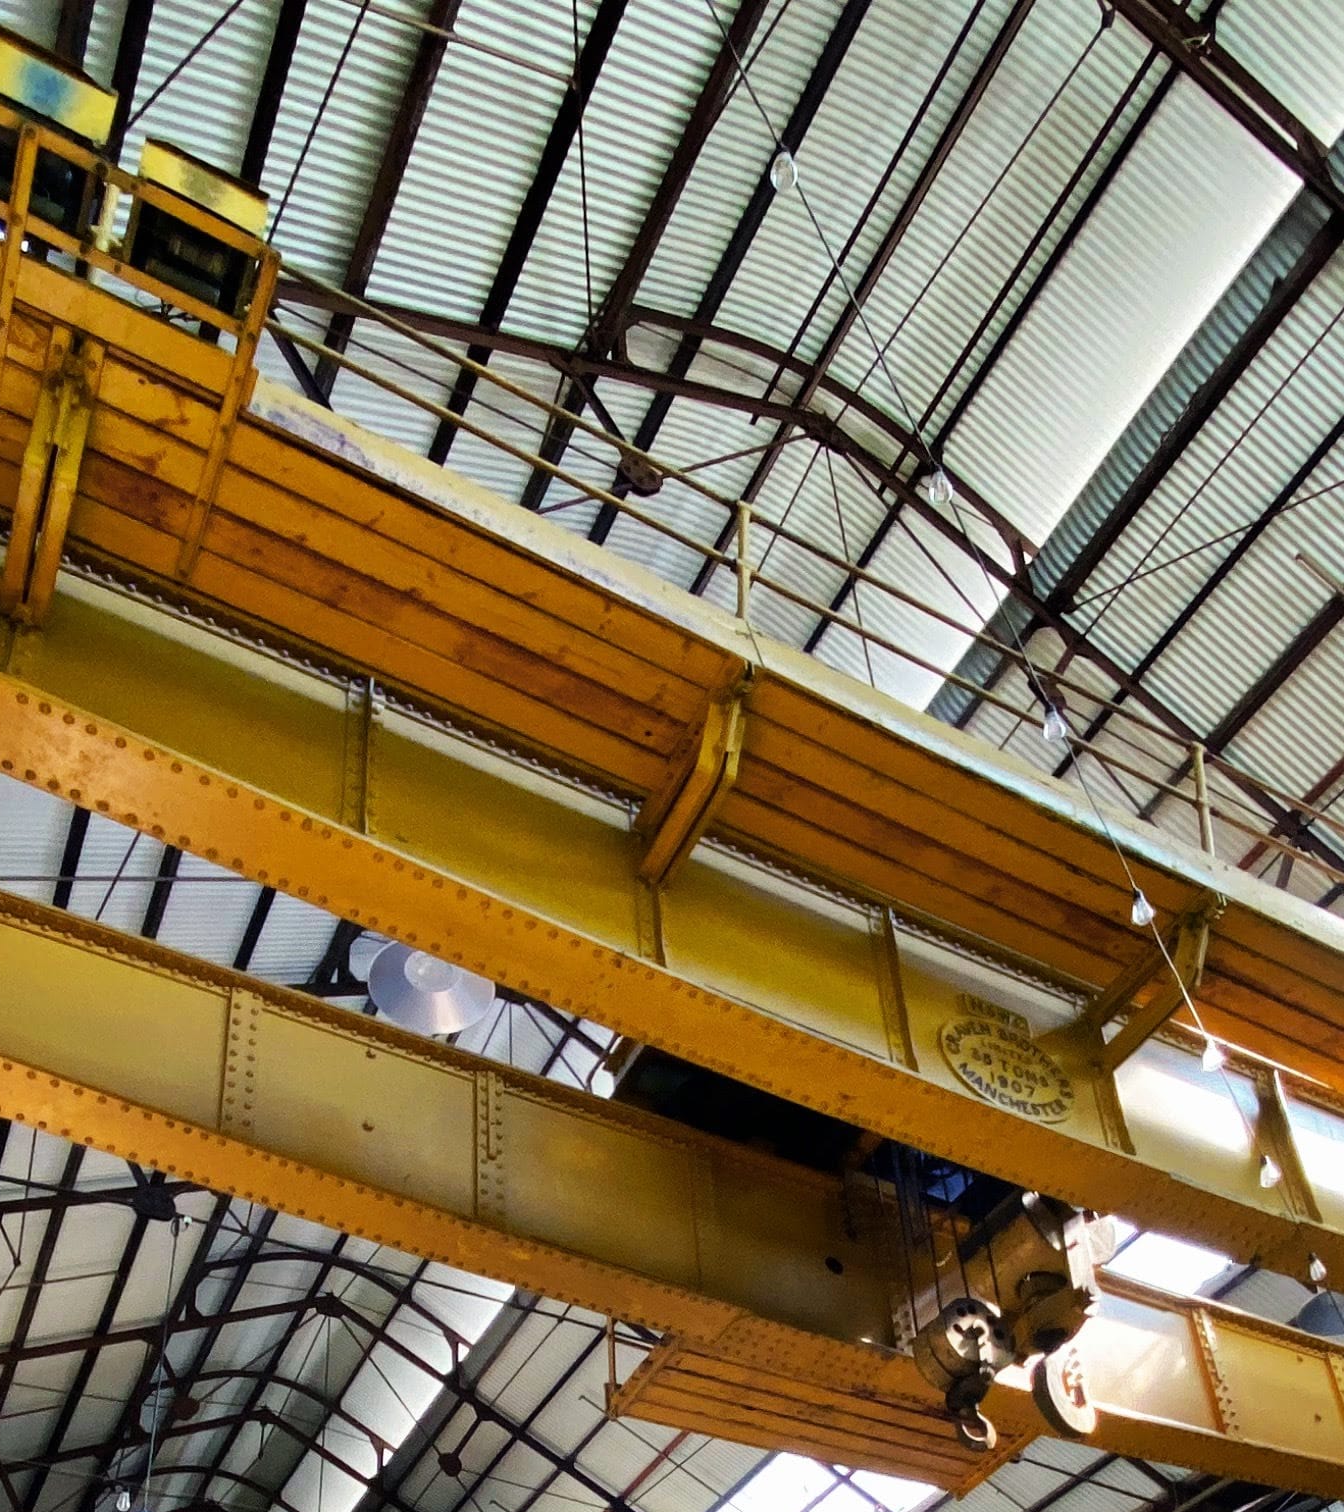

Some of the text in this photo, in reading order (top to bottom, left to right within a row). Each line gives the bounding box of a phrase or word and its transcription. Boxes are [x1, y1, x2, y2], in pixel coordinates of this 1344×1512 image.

[945, 1019, 1074, 1099] CRAVEN BROTHERS
[998, 1059, 1049, 1088] TONS
[958, 1061, 1068, 1117] MANCHESTER
